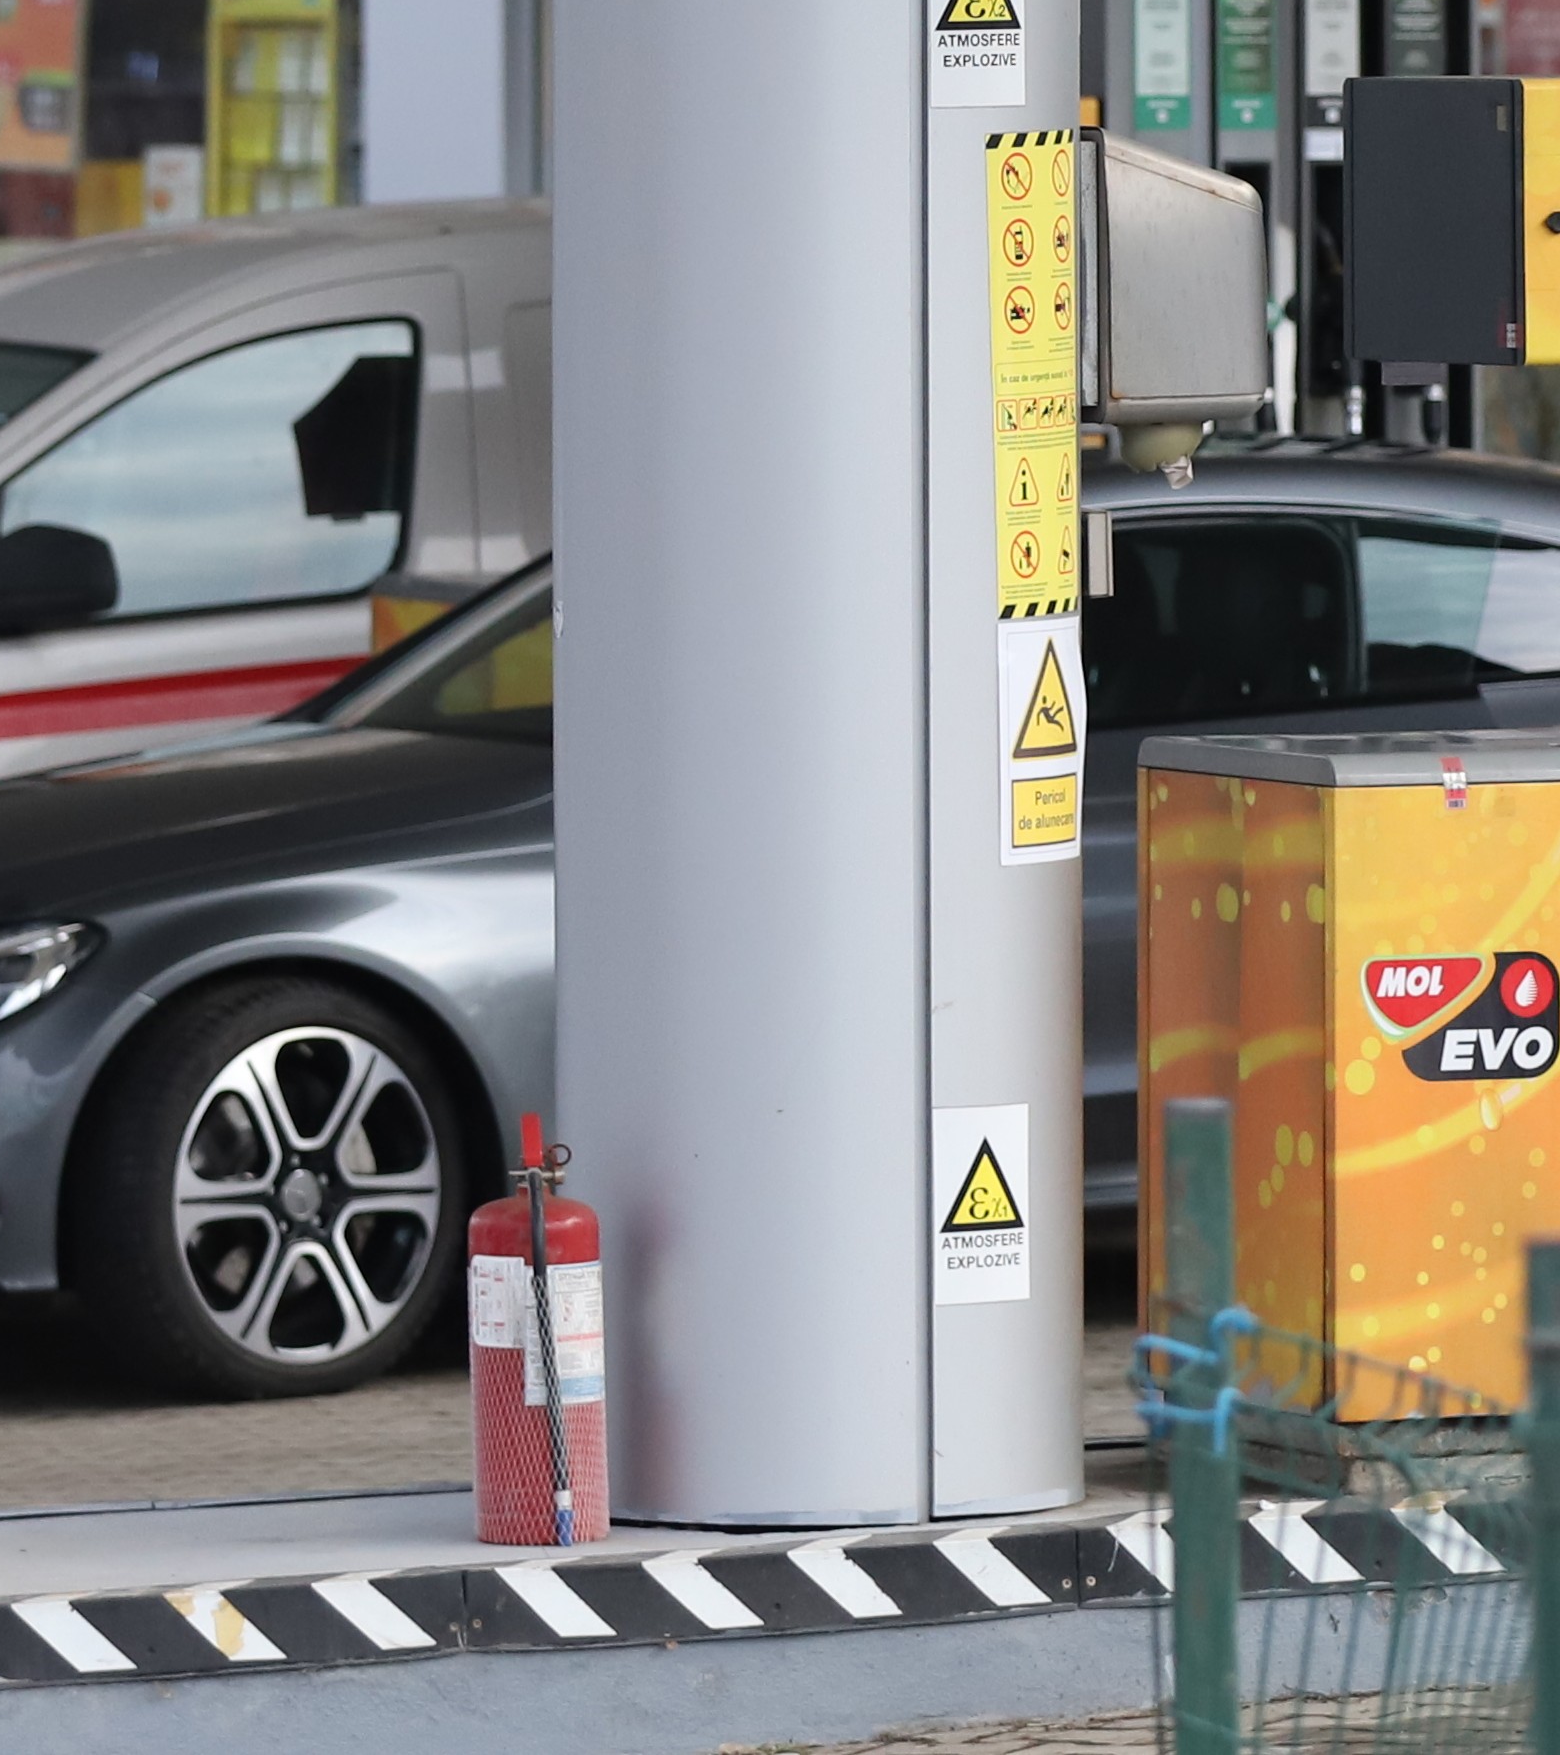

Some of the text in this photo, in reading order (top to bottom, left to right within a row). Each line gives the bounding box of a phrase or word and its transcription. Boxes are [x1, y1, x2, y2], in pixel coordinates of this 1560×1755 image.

[938, 33, 1020, 47] ATMOSFERE
[943, 54, 1016, 67] EXPLOZIVE
[1035, 789, 1066, 806] Pericol
[1018, 815, 1032, 830] de
[1376, 966, 1444, 997] MOL
[1440, 1027, 1554, 1072] EVO
[942, 1232, 1024, 1250] ATMOSFERE
[947, 1253, 1020, 1270] EXPLOZIVE
